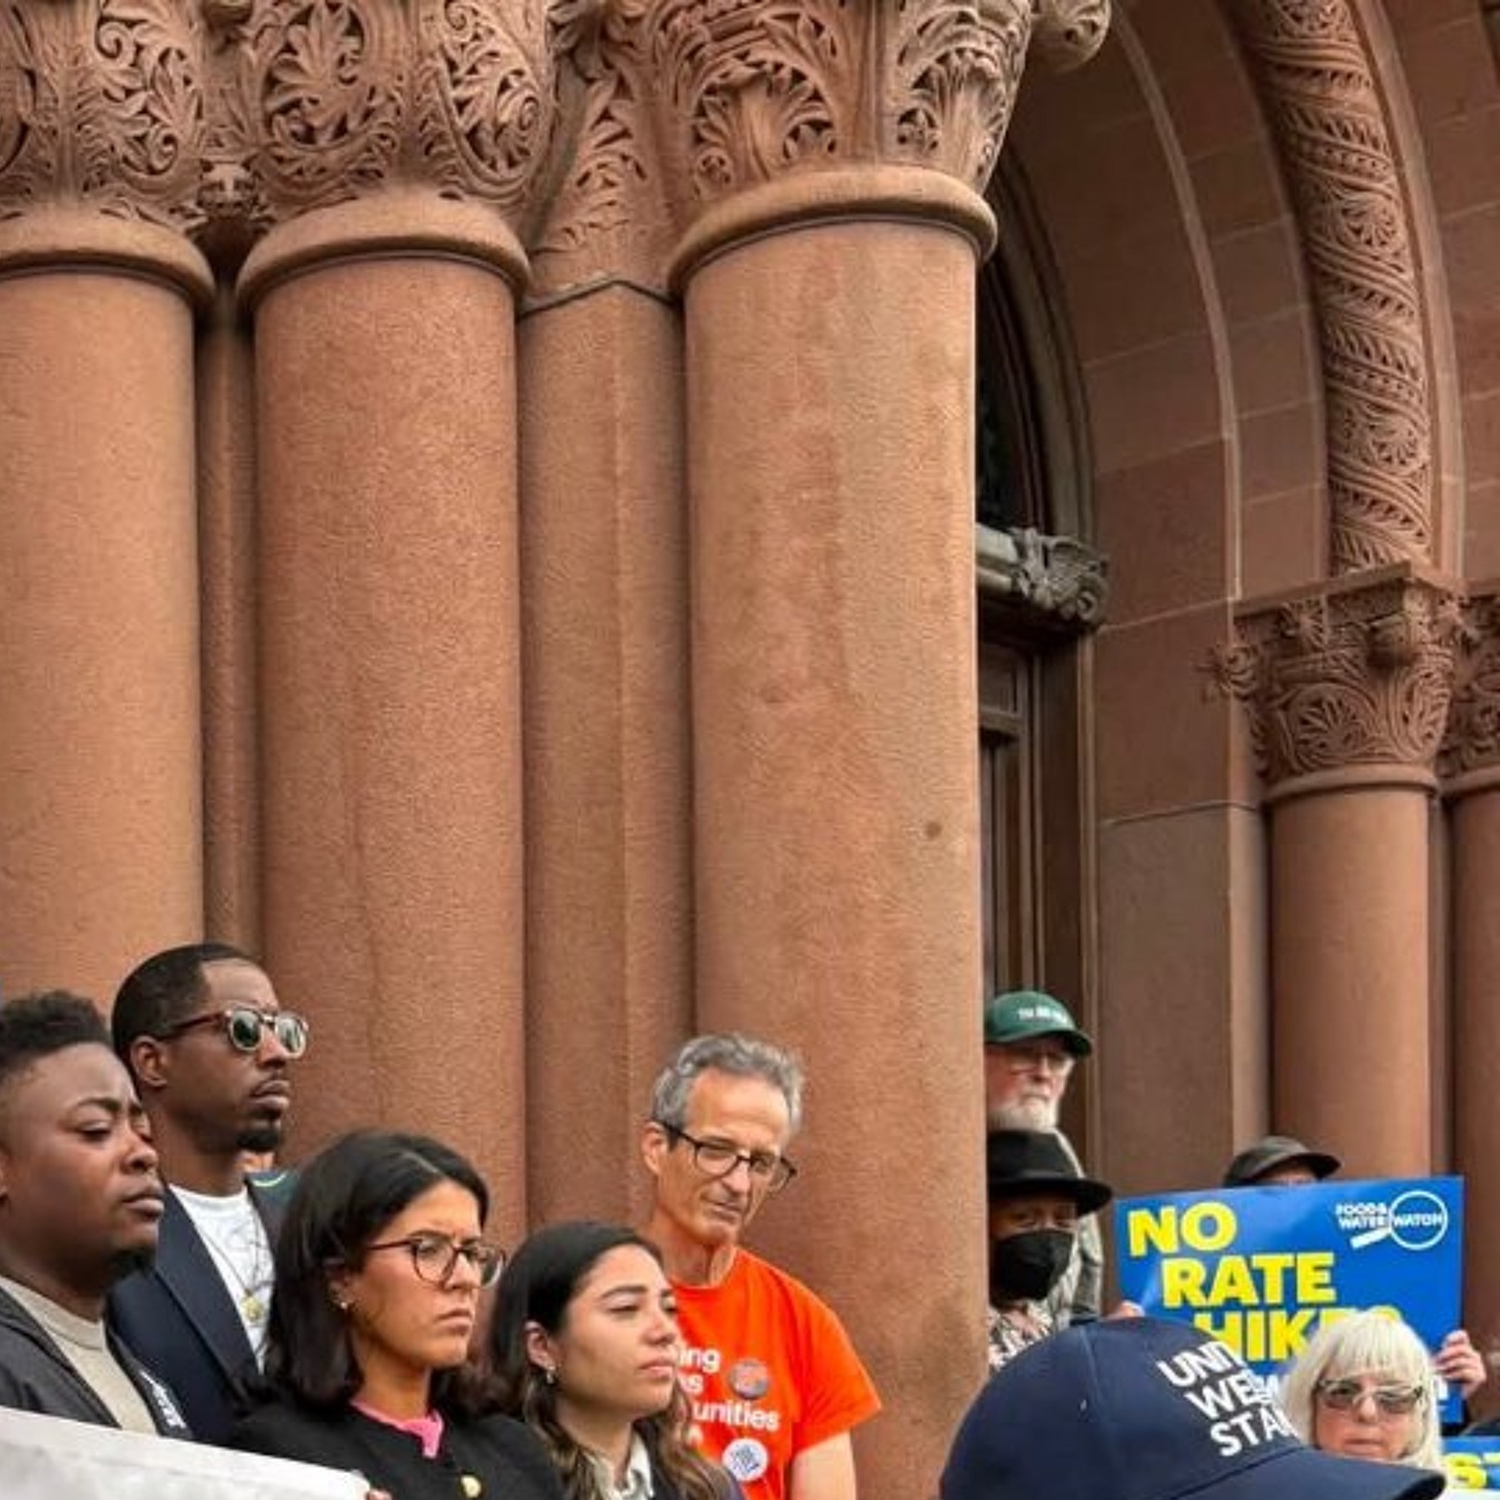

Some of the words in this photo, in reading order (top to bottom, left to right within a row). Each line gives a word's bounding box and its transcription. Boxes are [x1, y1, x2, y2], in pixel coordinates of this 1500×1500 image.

[1128, 1202, 1237, 1256] NO
[1394, 1212, 1443, 1227] WATCH
[1162, 1252, 1336, 1307] RATE
[1194, 1306, 1402, 1362] HIK
[693, 1399, 780, 1432] unities
